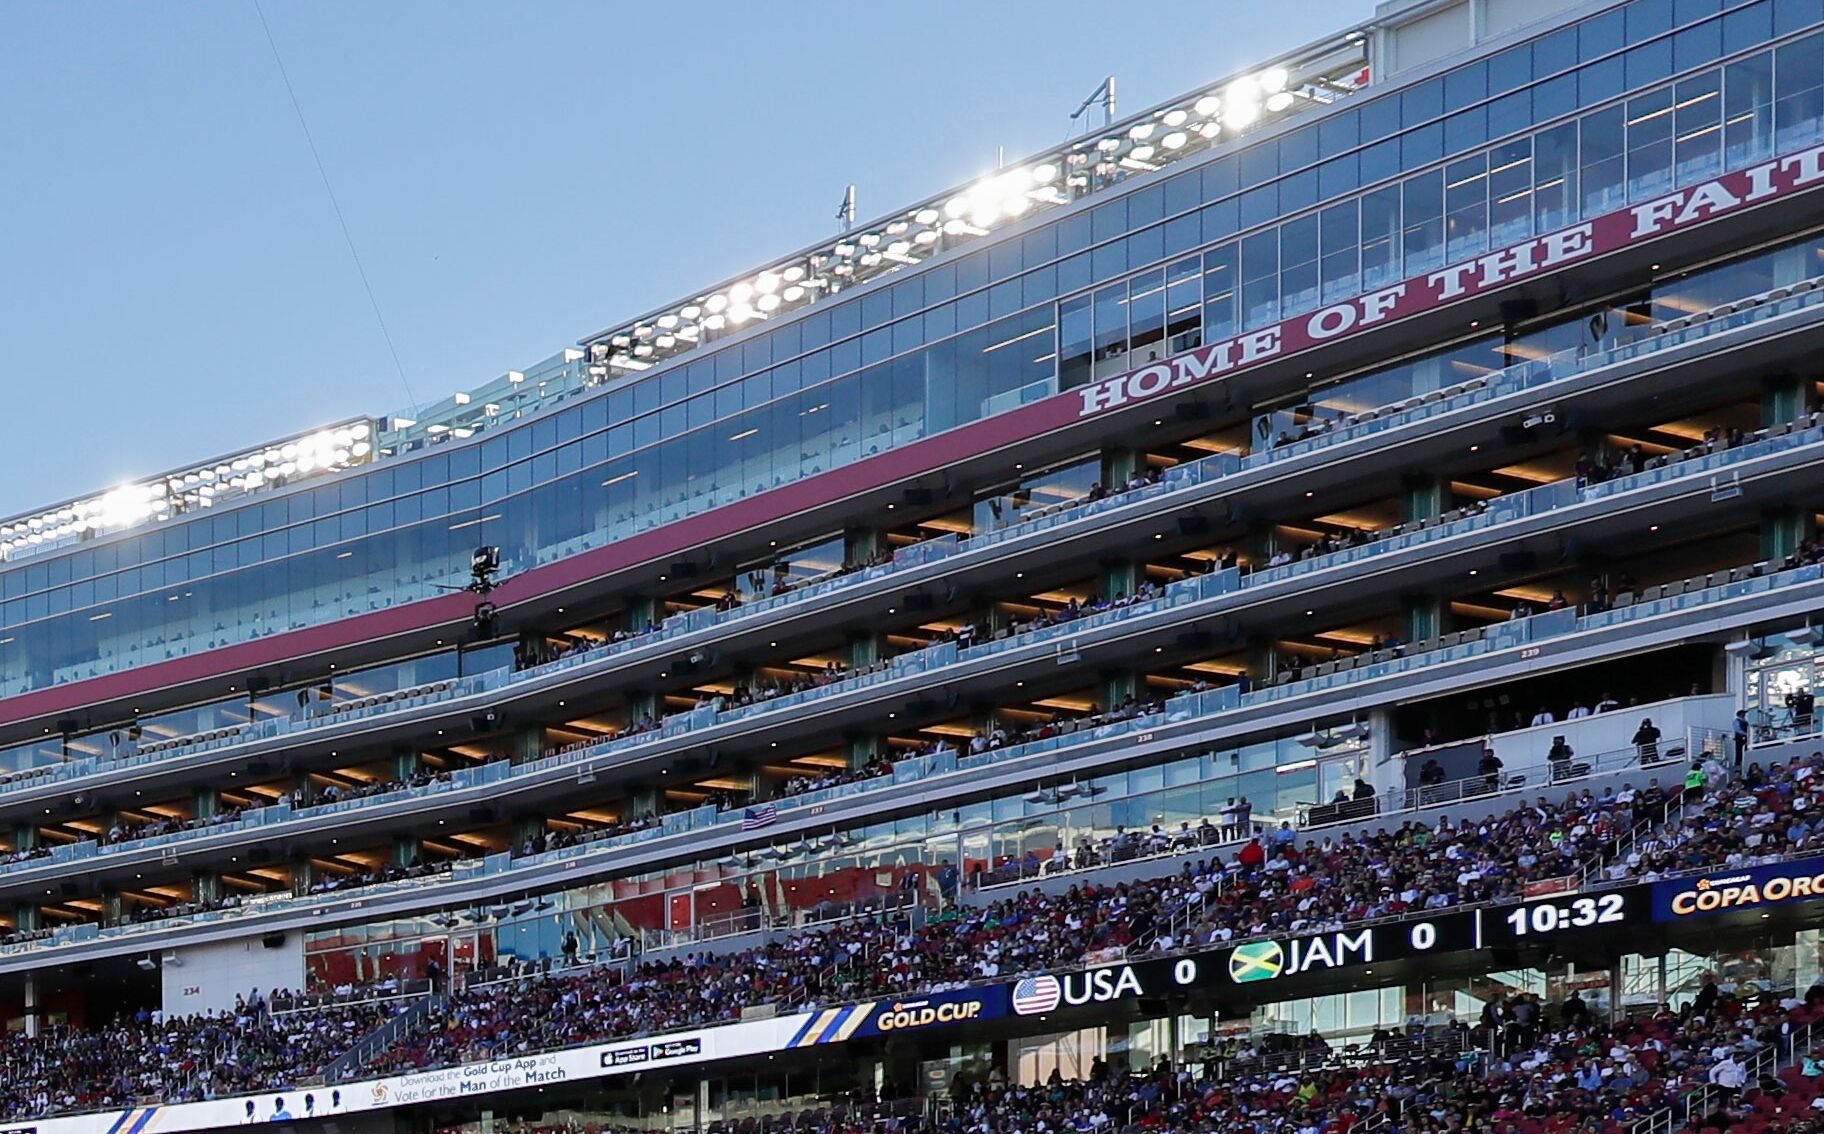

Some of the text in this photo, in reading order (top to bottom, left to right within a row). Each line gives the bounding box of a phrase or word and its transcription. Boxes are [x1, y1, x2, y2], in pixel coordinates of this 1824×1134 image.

[1079, 324, 1282, 419] HOME
[1307, 283, 1406, 340] OF
[1427, 221, 1596, 303] THE
[1507, 892, 1626, 937] 10:32
[1671, 884, 1761, 916] COPA
[1285, 929, 1373, 977] JAM
[1411, 922, 1437, 950] 0
[1063, 965, 1144, 1006] USA
[1174, 959, 1197, 985] 0
[183, 985, 201, 997] 234
[877, 1008, 936, 1031] GOLD
[393, 1066, 567, 1103] Vote for the Man of the Match
[399, 1054, 557, 1088] Download the Gold Cup App and
